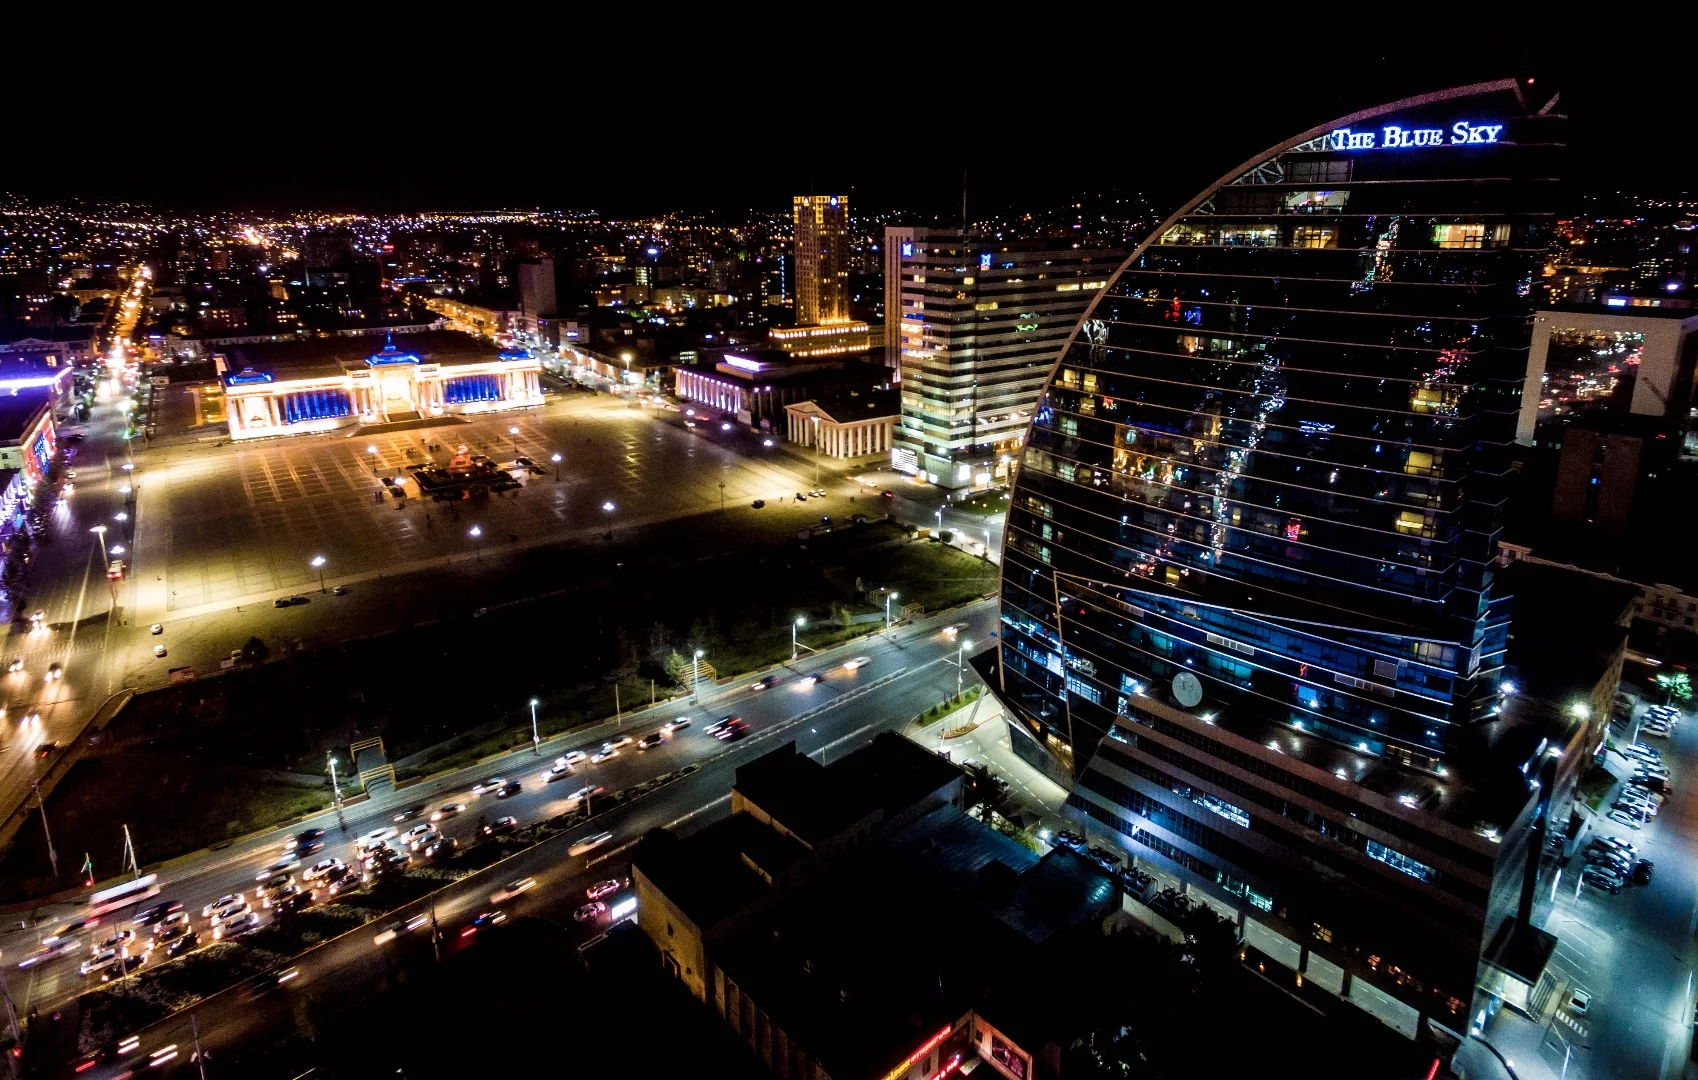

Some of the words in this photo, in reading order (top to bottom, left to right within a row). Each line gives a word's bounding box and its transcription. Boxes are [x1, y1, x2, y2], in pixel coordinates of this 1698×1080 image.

[1332, 129, 1375, 149] THE
[1382, 126, 1443, 147] BLUE
[1450, 122, 1502, 144] SKY
